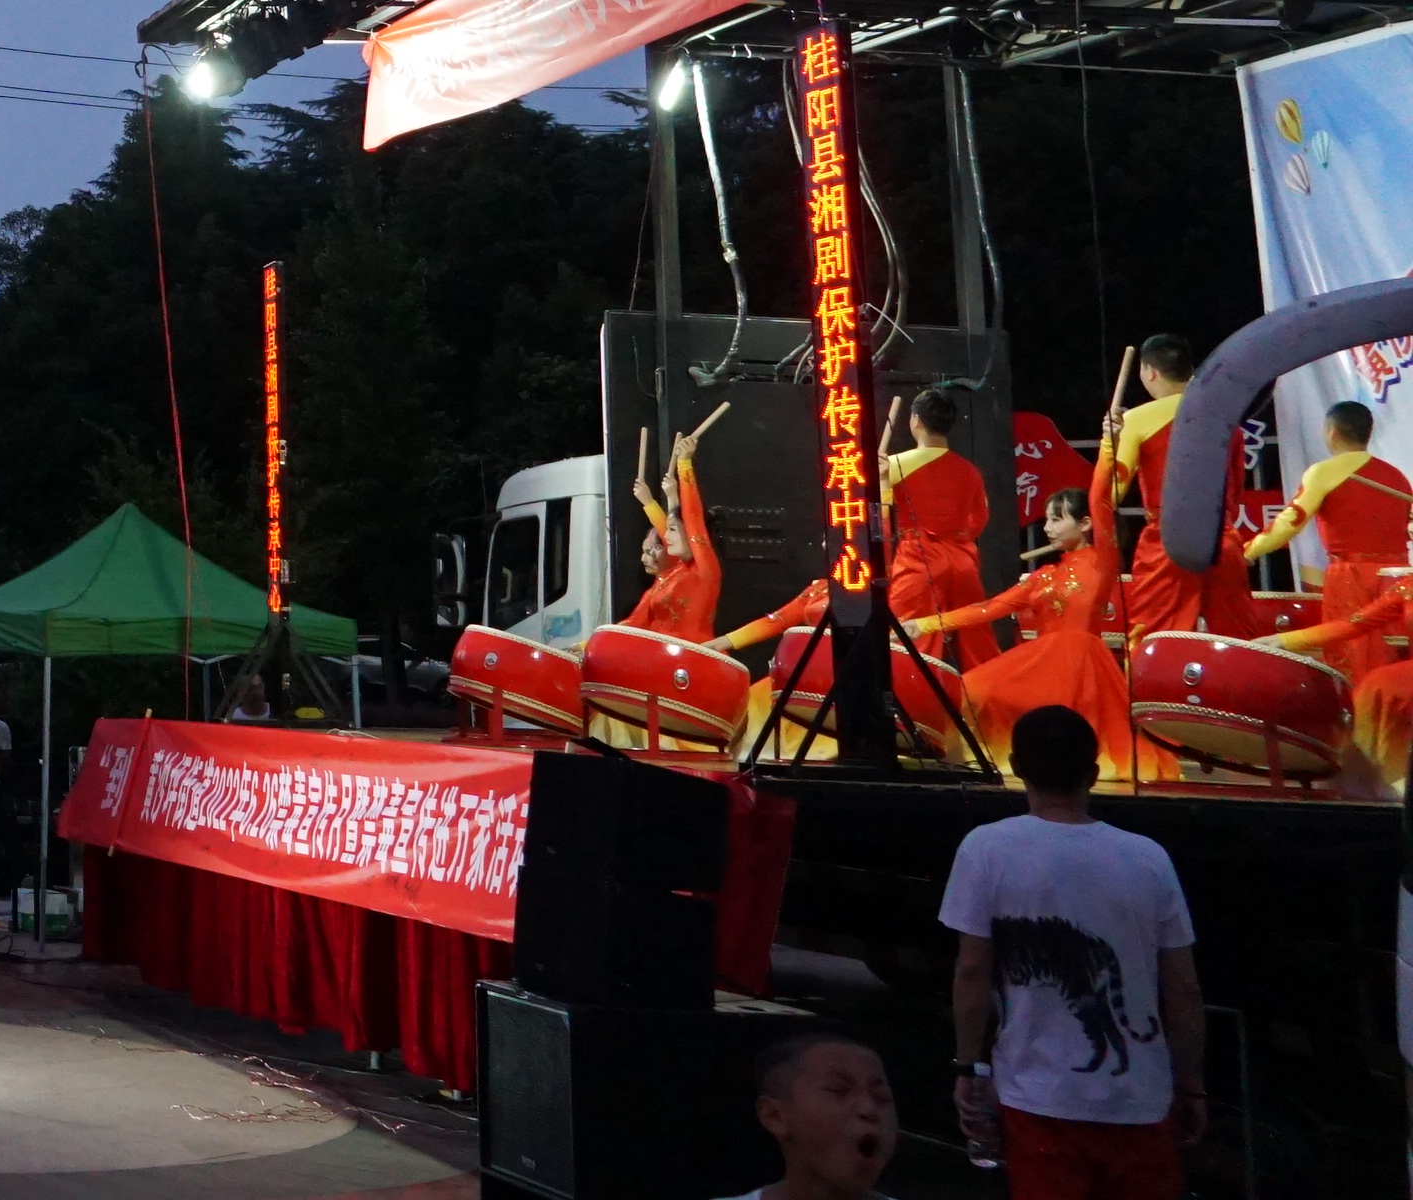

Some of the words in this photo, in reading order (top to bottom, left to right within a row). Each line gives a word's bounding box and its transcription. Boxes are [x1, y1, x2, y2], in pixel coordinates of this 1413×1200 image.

[802, 33, 870, 592] 桂阳县湘剧保护传承中心
